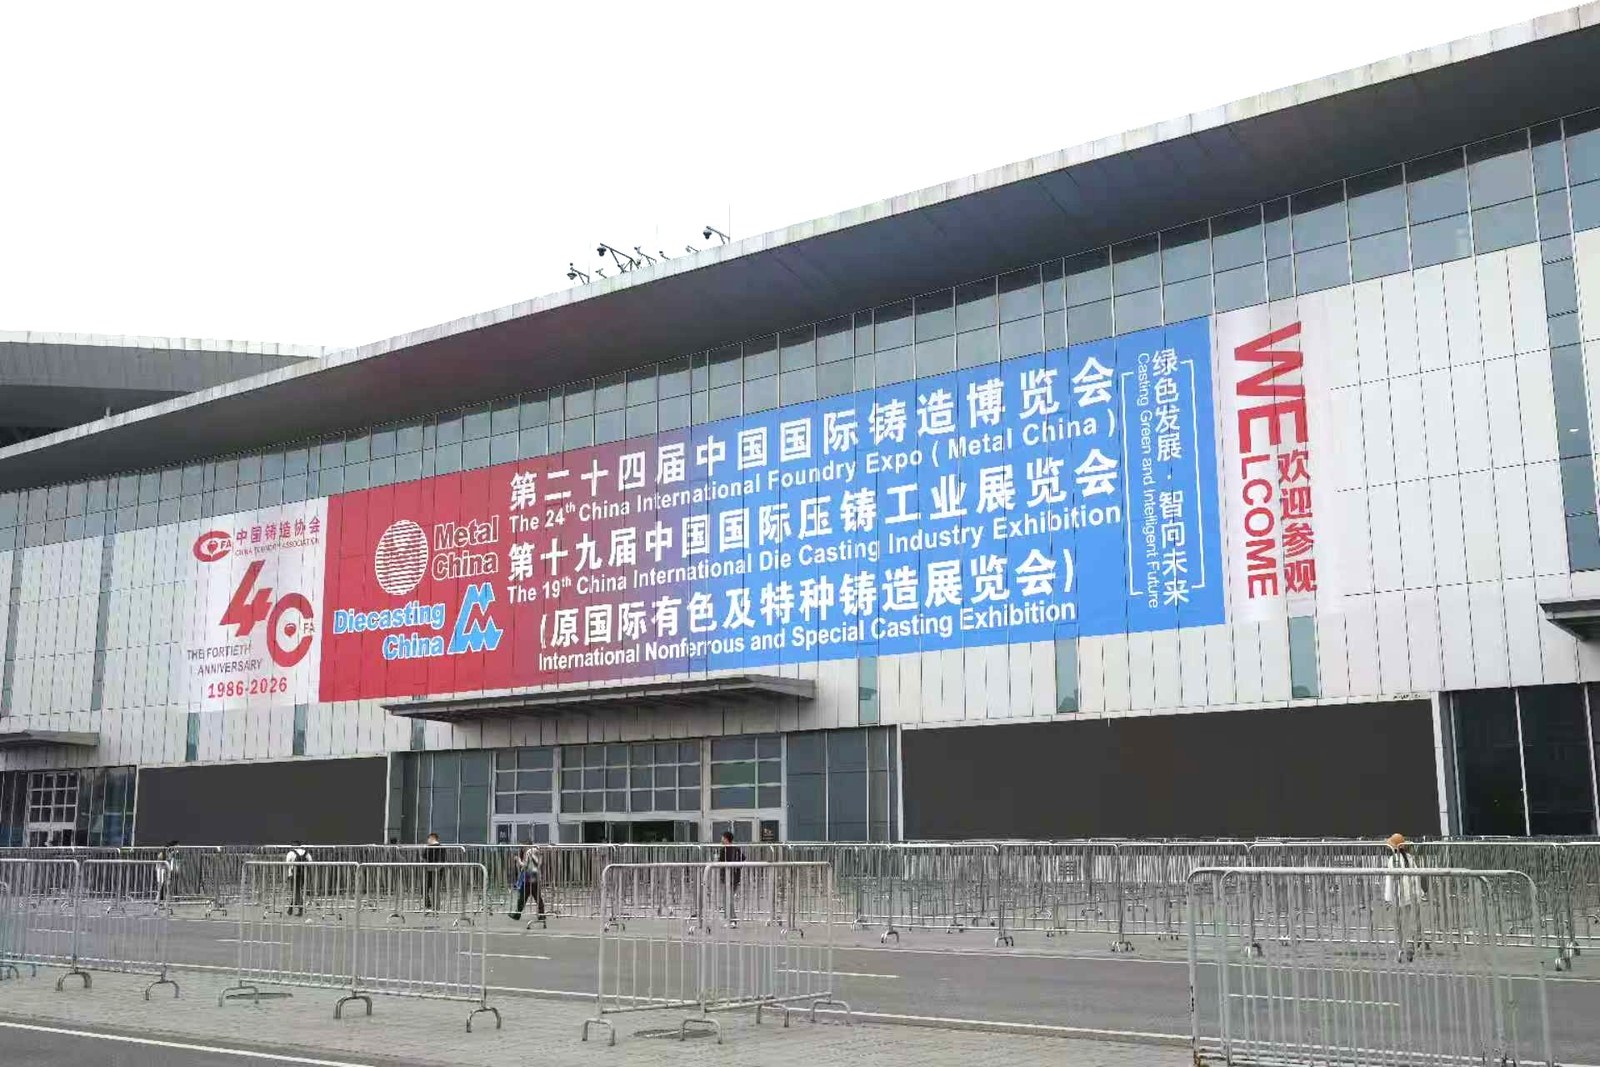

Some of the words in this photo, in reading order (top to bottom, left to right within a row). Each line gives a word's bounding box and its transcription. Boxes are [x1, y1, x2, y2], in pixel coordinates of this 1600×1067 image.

[1137, 353, 1152, 406] Casting
[510, 357, 1114, 511] 第二十四届中国国际铸造博览会
[1140, 410, 1153, 454] Green
[1142, 457, 1156, 486] and
[1234, 321, 1309, 599] WELCOME
[508, 448, 1119, 581] 第十九届中国国际压铸工业展览会
[509, 515, 540, 534] The
[545, 502, 576, 528] 24th
[579, 501, 630, 523] China
[637, 477, 760, 513] International
[768, 459, 857, 490] Foundry
[866, 449, 922, 475] Expo
[236, 516, 321, 545] 中国铸造协会
[434, 515, 500, 550] Metal
[1143, 489, 1158, 558] Intelligent
[1277, 449, 1318, 593] 欢迎参观
[432, 550, 499, 580] China
[507, 585, 537, 604] The
[542, 577, 572, 599] 19th
[576, 573, 627, 595] China
[633, 550, 752, 588] International
[759, 551, 792, 571] Die
[799, 539, 880, 566] Casting
[889, 524, 984, 554] Industry
[993, 504, 1121, 540] Exhibition
[1146, 560, 1160, 608] Future
[333, 600, 446, 634] Diecasting
[539, 643, 640, 671] International
[645, 633, 744, 661] Nonferrous
[751, 629, 786, 650] and
[791, 619, 865, 650] Special
[871, 612, 953, 639] Casting
[960, 600, 1076, 630] Exhibition
[187, 648, 205, 660] THE
[206, 644, 252, 658] FORTIETH
[197, 659, 263, 675] ANNIVERSARY
[382, 632, 445, 660] China
[208, 677, 288, 698] 1986-2026
